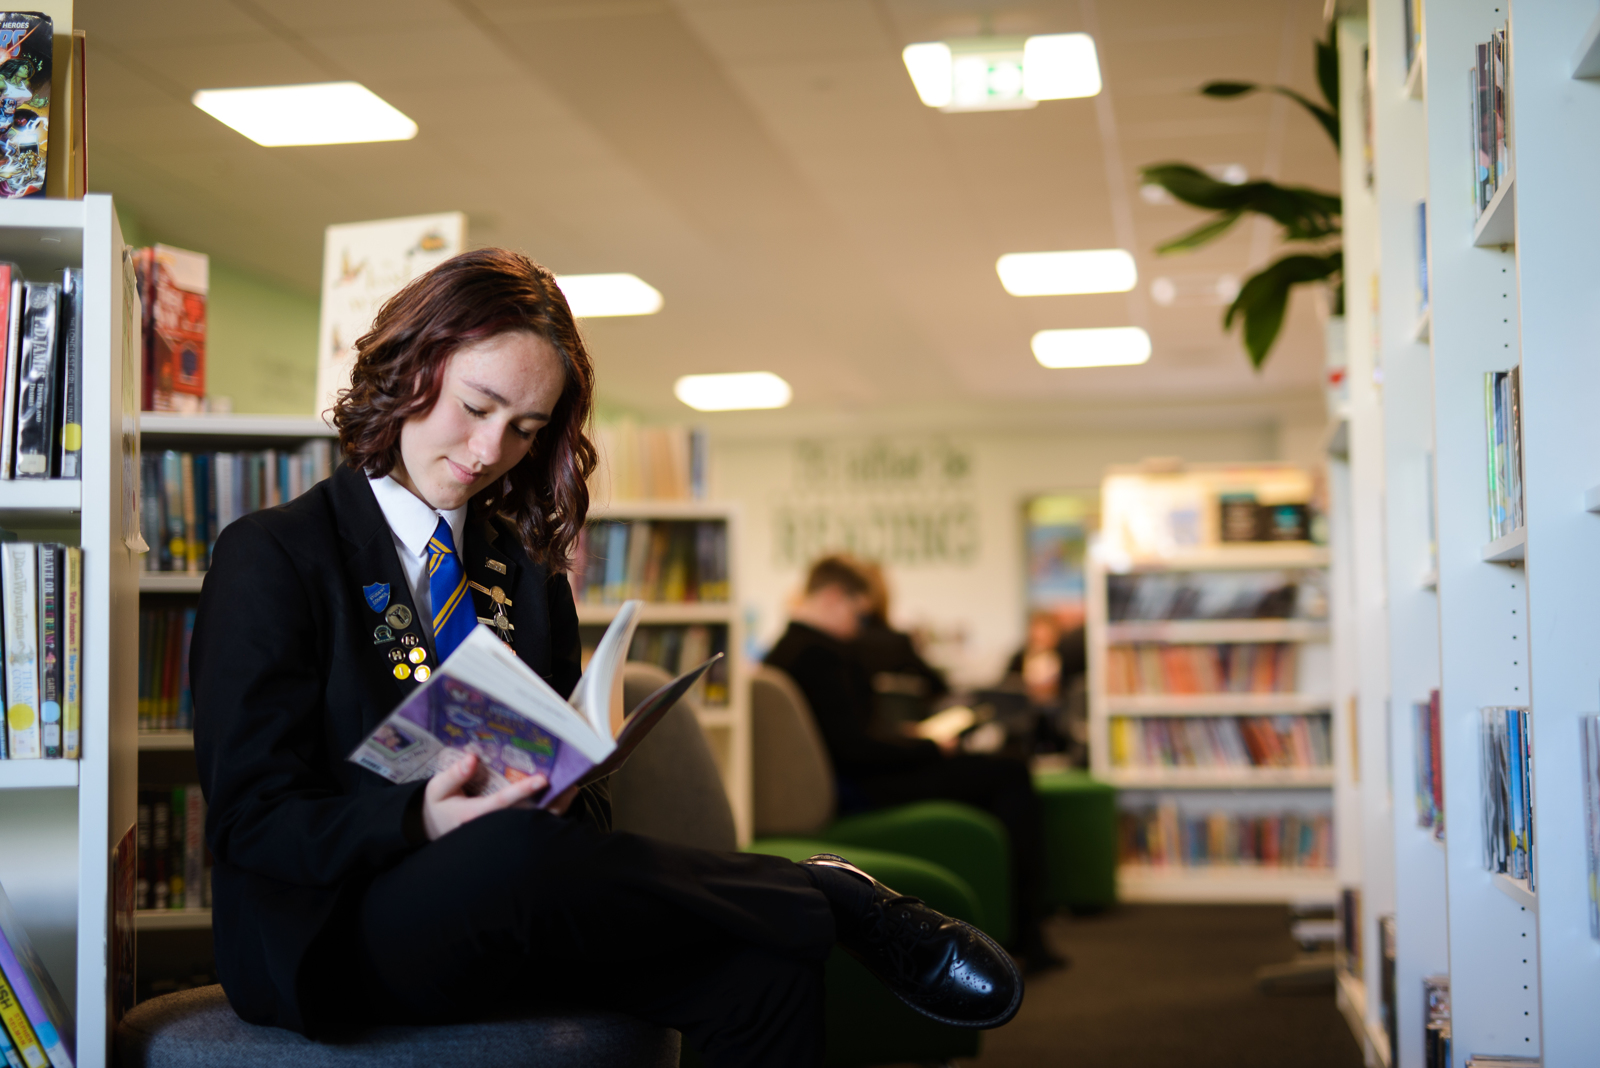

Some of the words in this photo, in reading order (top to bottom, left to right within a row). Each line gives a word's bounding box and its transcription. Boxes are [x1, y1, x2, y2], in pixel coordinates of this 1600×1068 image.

[45, 550, 54, 578] DEATH
[45, 582, 54, 593] OR
[45, 596, 54, 609] ICE
[69, 591, 77, 609] Pete
[45, 612, 55, 648] CREAM?
[69, 612, 77, 645] Johnson
[405, 635, 415, 645] H
[391, 650, 402, 661] H
[47, 678, 55, 701] GARETH
[8, 1017, 26, 1046] KELMAN
[14, 1012, 33, 1043] STEPHEN
